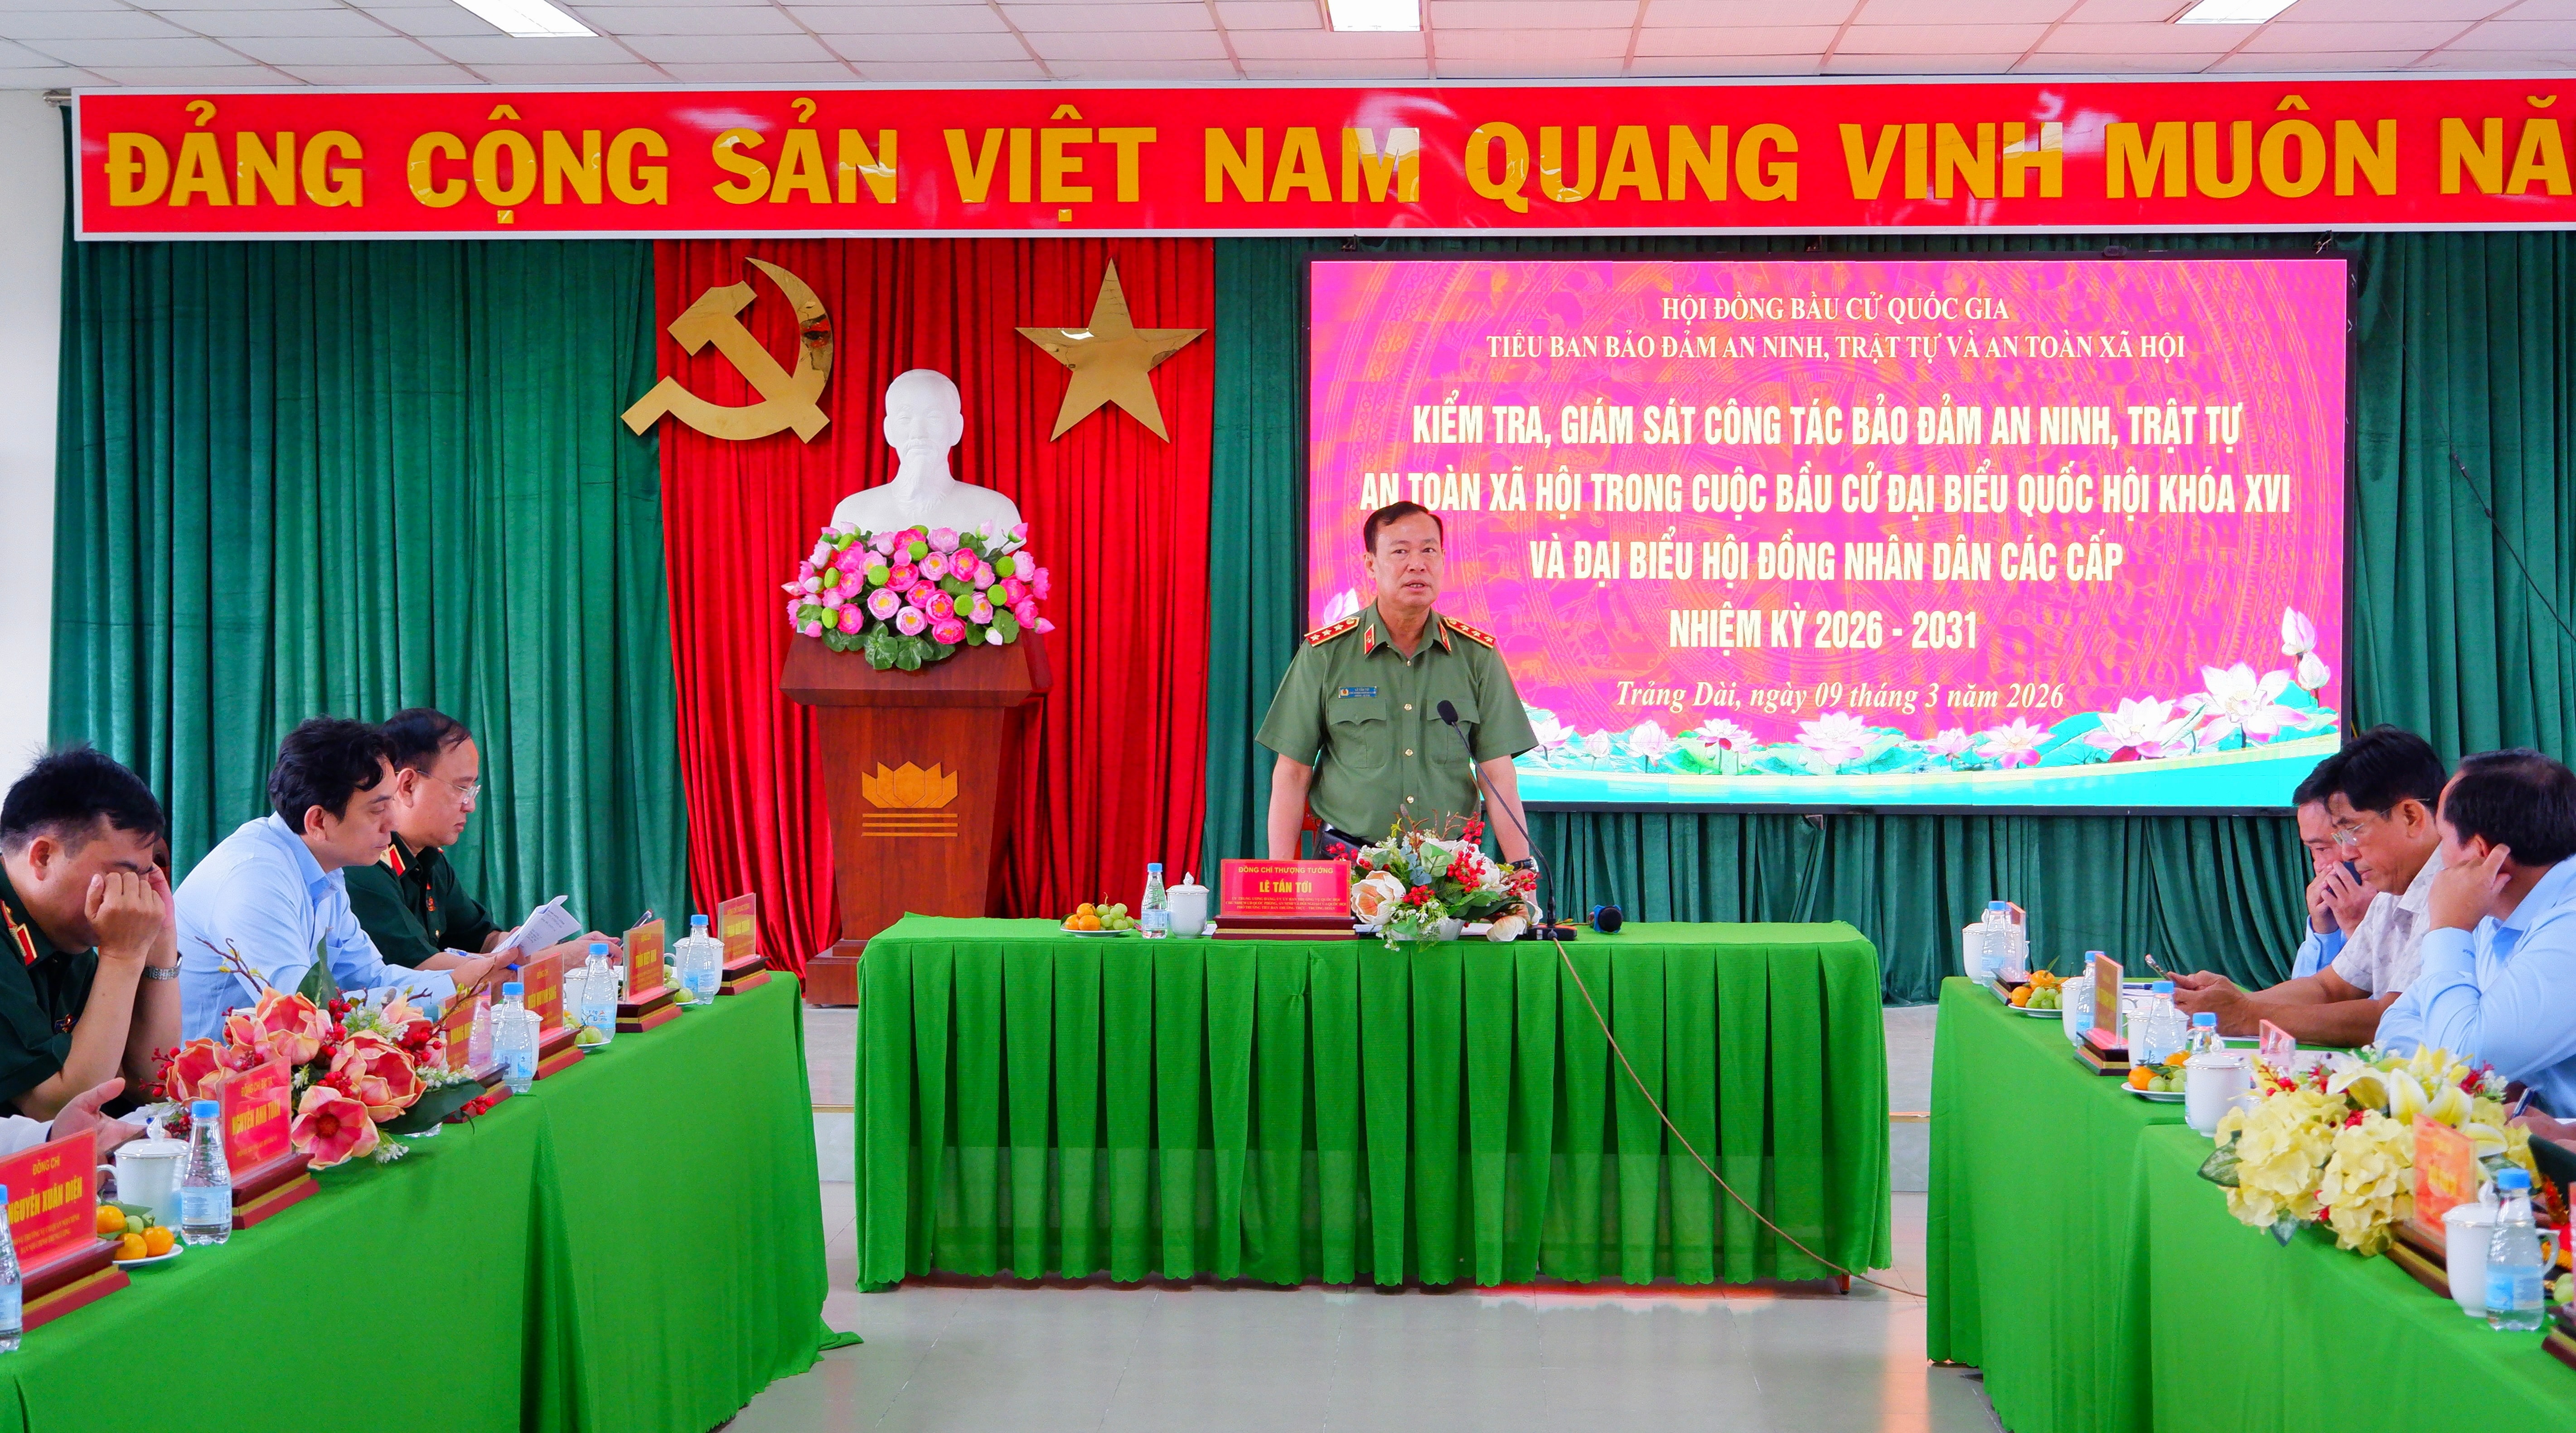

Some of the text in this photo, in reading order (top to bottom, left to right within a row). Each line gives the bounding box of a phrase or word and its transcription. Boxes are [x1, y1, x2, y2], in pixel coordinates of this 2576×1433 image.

[105, 95, 2573, 224] ĐẢNG CỘNG SẢN VIỆT NAM QUANG VINH MUÔN NĂ
[1661, 290, 2010, 326] HỘI ĐỒNG BẦU CỬ QUỐC GIA
[1486, 329, 2185, 365] TIỂU BAN BẢO ĐẢM AN NINH, TRẬT TỰ VÀ AN TOÀN XÃ HỘI
[1413, 389, 2243, 454] KIỂM TRA, GIÁM SÁT CÔNG TÁC BẢO ĐẢM AN NINH, TRẬT TỰ
[1359, 458, 2290, 522] AN TOÀN XÃ HỘI TRONG CUỘC BẦU CỬ ĐẠI BIỂU QUỐC HỘI KHÓA XVI
[1529, 525, 2124, 589] VÀ ĐẠI BIỂU HỘI ĐỒNG NHÂN DÂN CÁC CẤP
[1669, 600, 1977, 657] NHIỆM KỲ 2026 - 2031
[1616, 680, 2065, 715] Trảng Dài, ngày 09 tháng 3 năm 2026
[1259, 878, 1312, 893] LÊ TẤN TỚI
[1275, 867, 1306, 875] THƯỢNG
